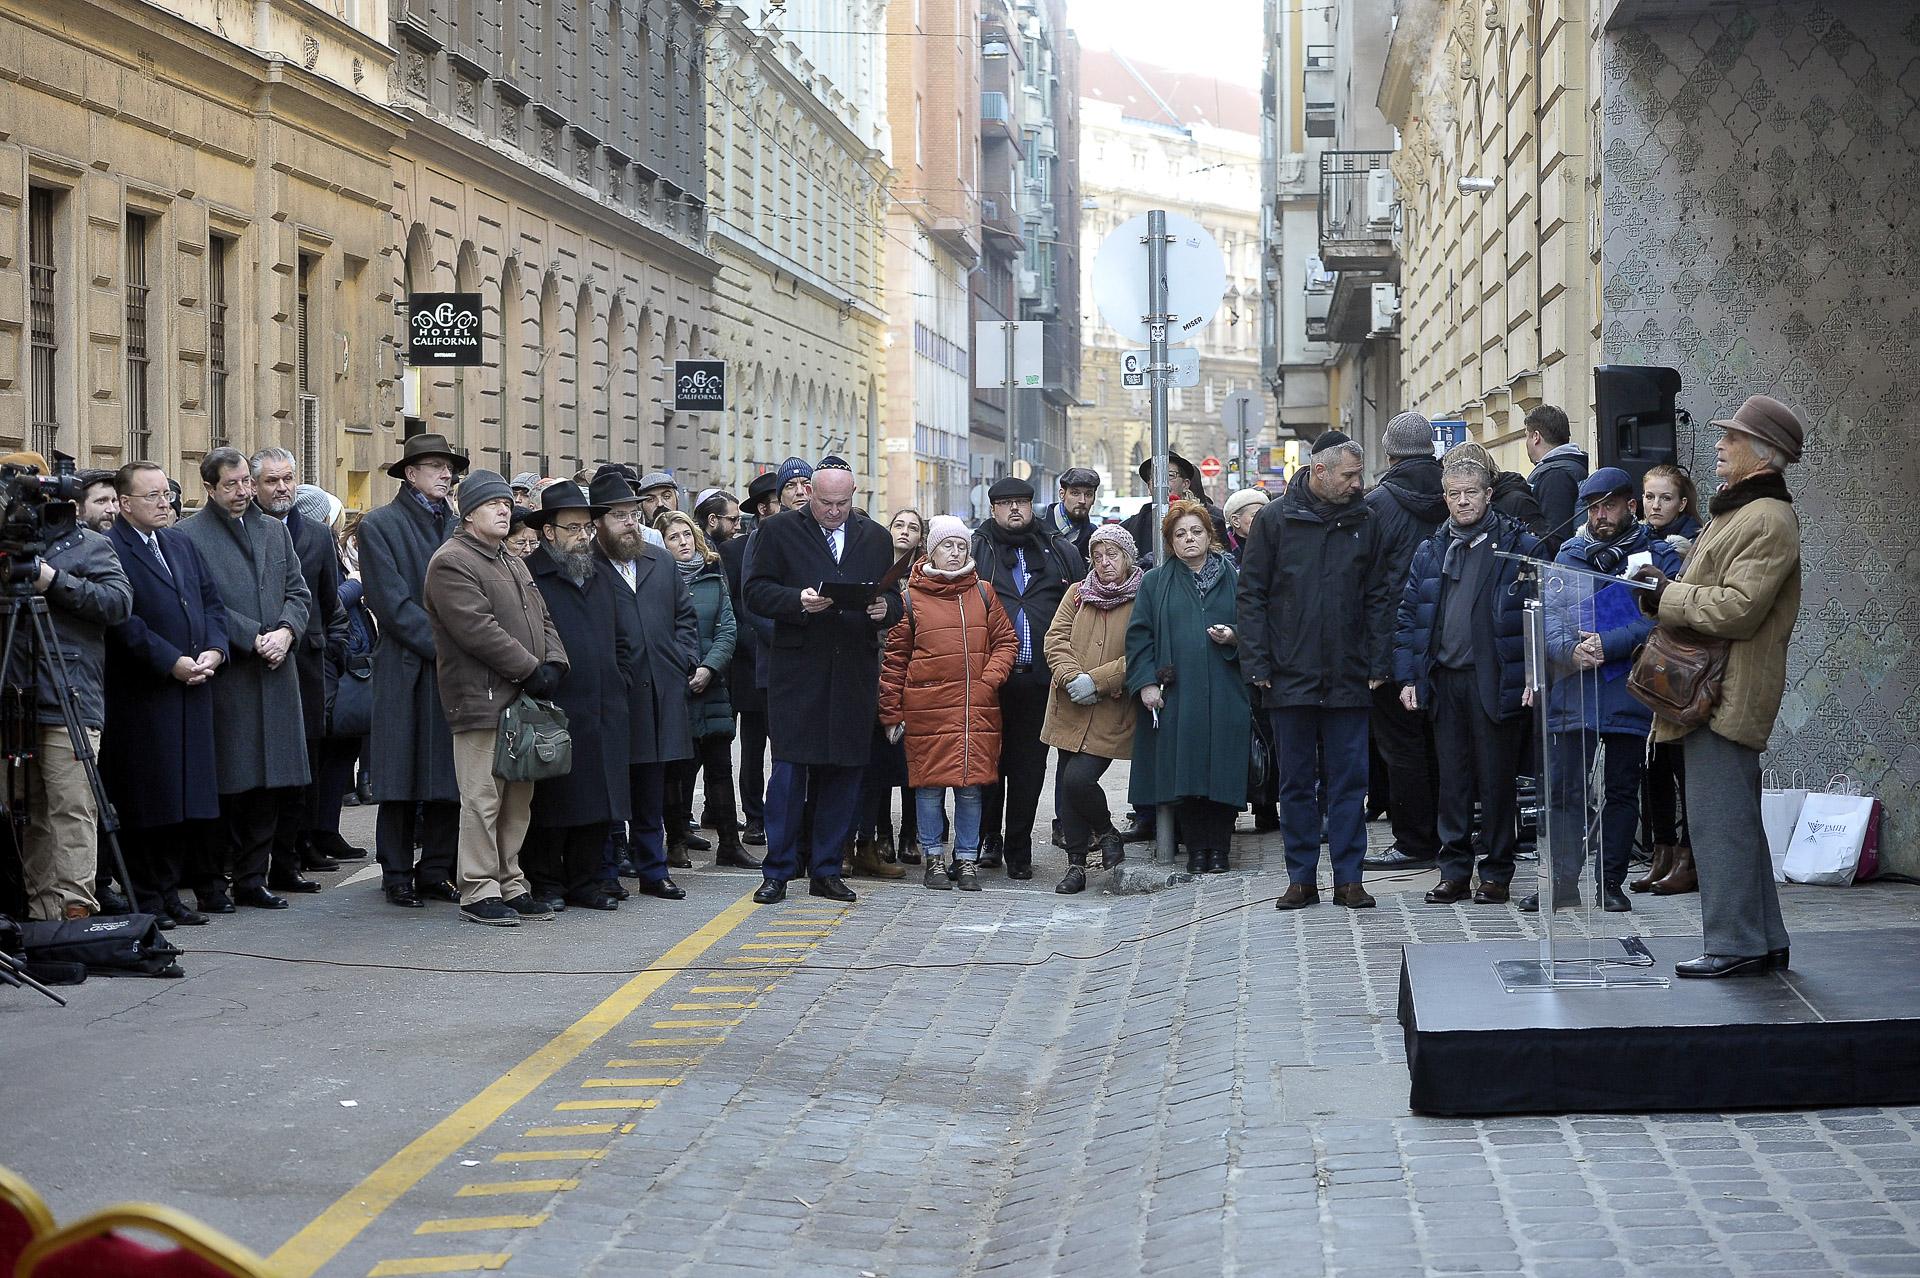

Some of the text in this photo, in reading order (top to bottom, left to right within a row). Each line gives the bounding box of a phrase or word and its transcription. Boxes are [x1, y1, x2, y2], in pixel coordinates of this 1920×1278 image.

[1182, 316, 1203, 331] MISER
[419, 328, 471, 336] HOTEL
[412, 337, 478, 346] CALIFORNIA
[1823, 824, 1847, 833] EMIH
